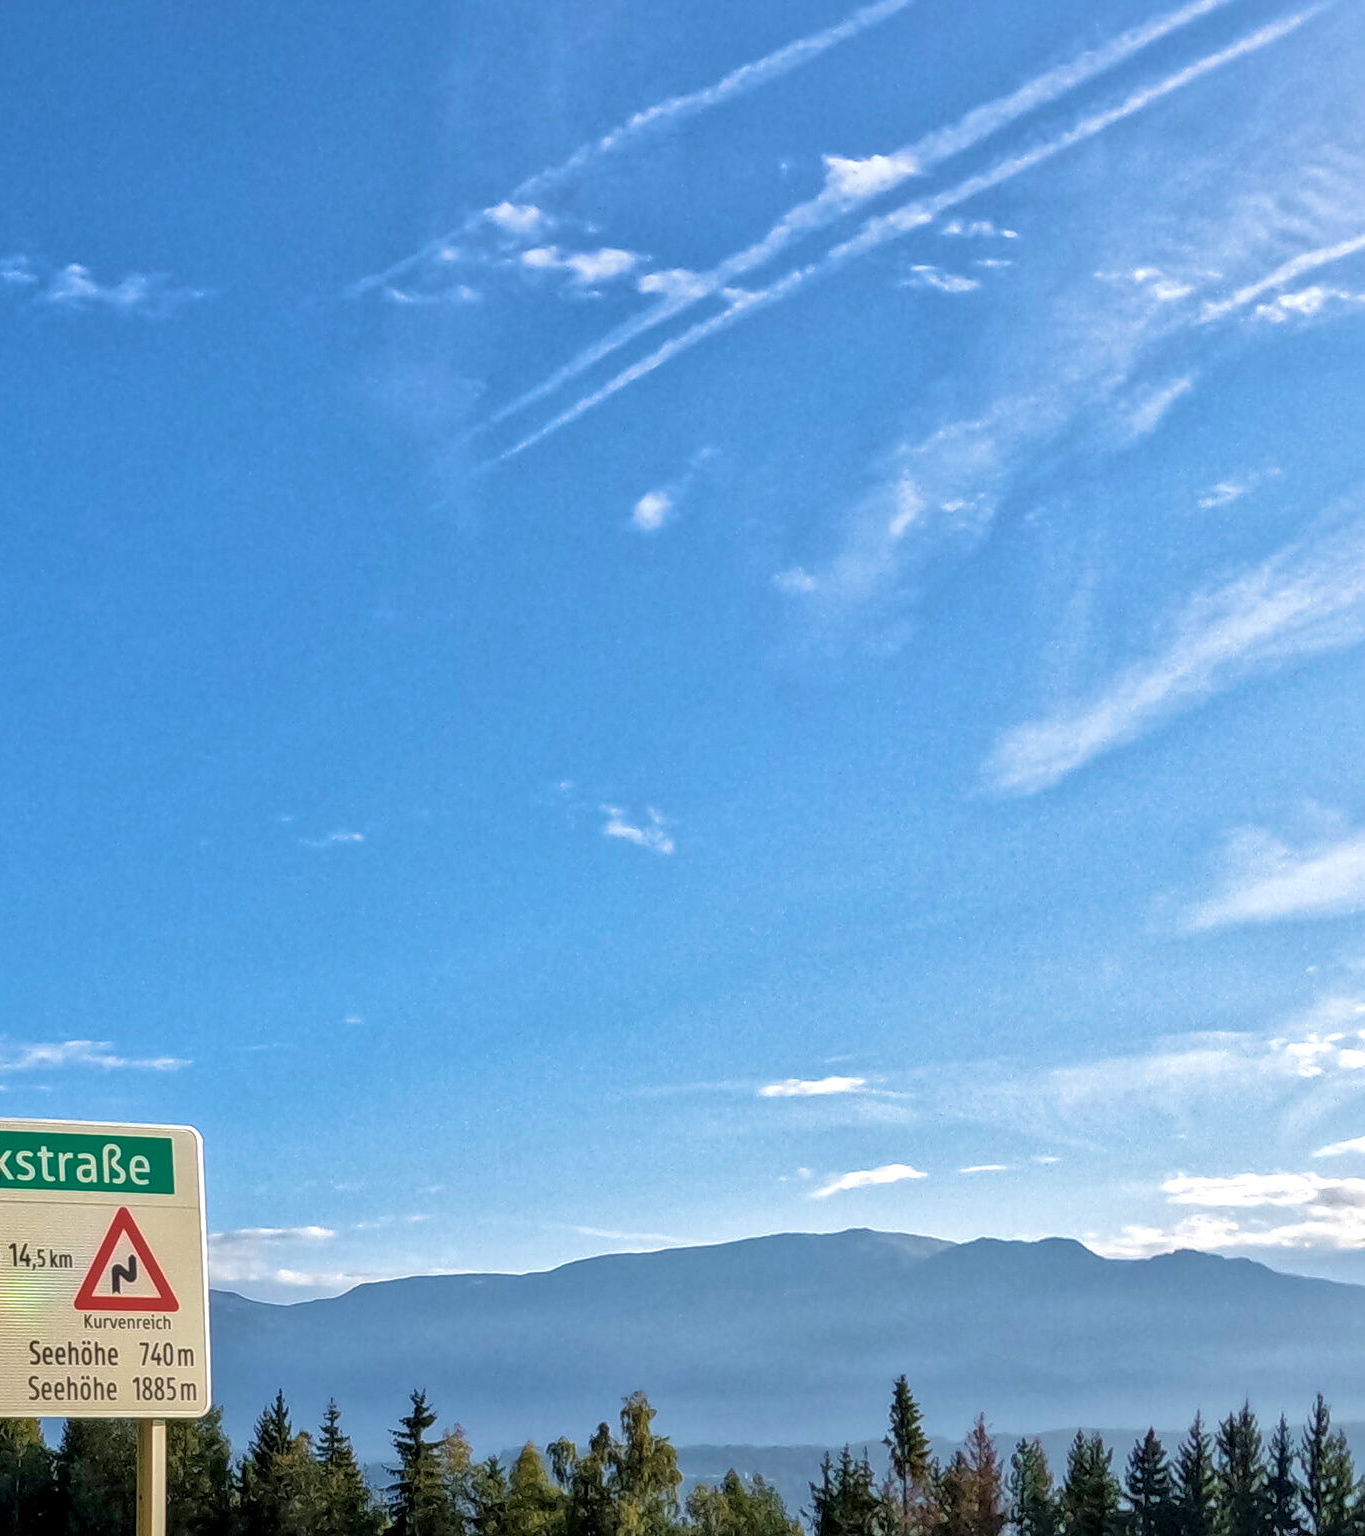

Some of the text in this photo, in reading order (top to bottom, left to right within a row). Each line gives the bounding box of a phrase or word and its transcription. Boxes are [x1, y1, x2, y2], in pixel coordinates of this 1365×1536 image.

[8, 1243, 46, 1270] 14,5
[49, 1249, 73, 1268] km
[83, 1313, 172, 1330] Kurvenreich
[29, 1340, 119, 1366] Seehöhe
[28, 1375, 118, 1401] Seehöhe
